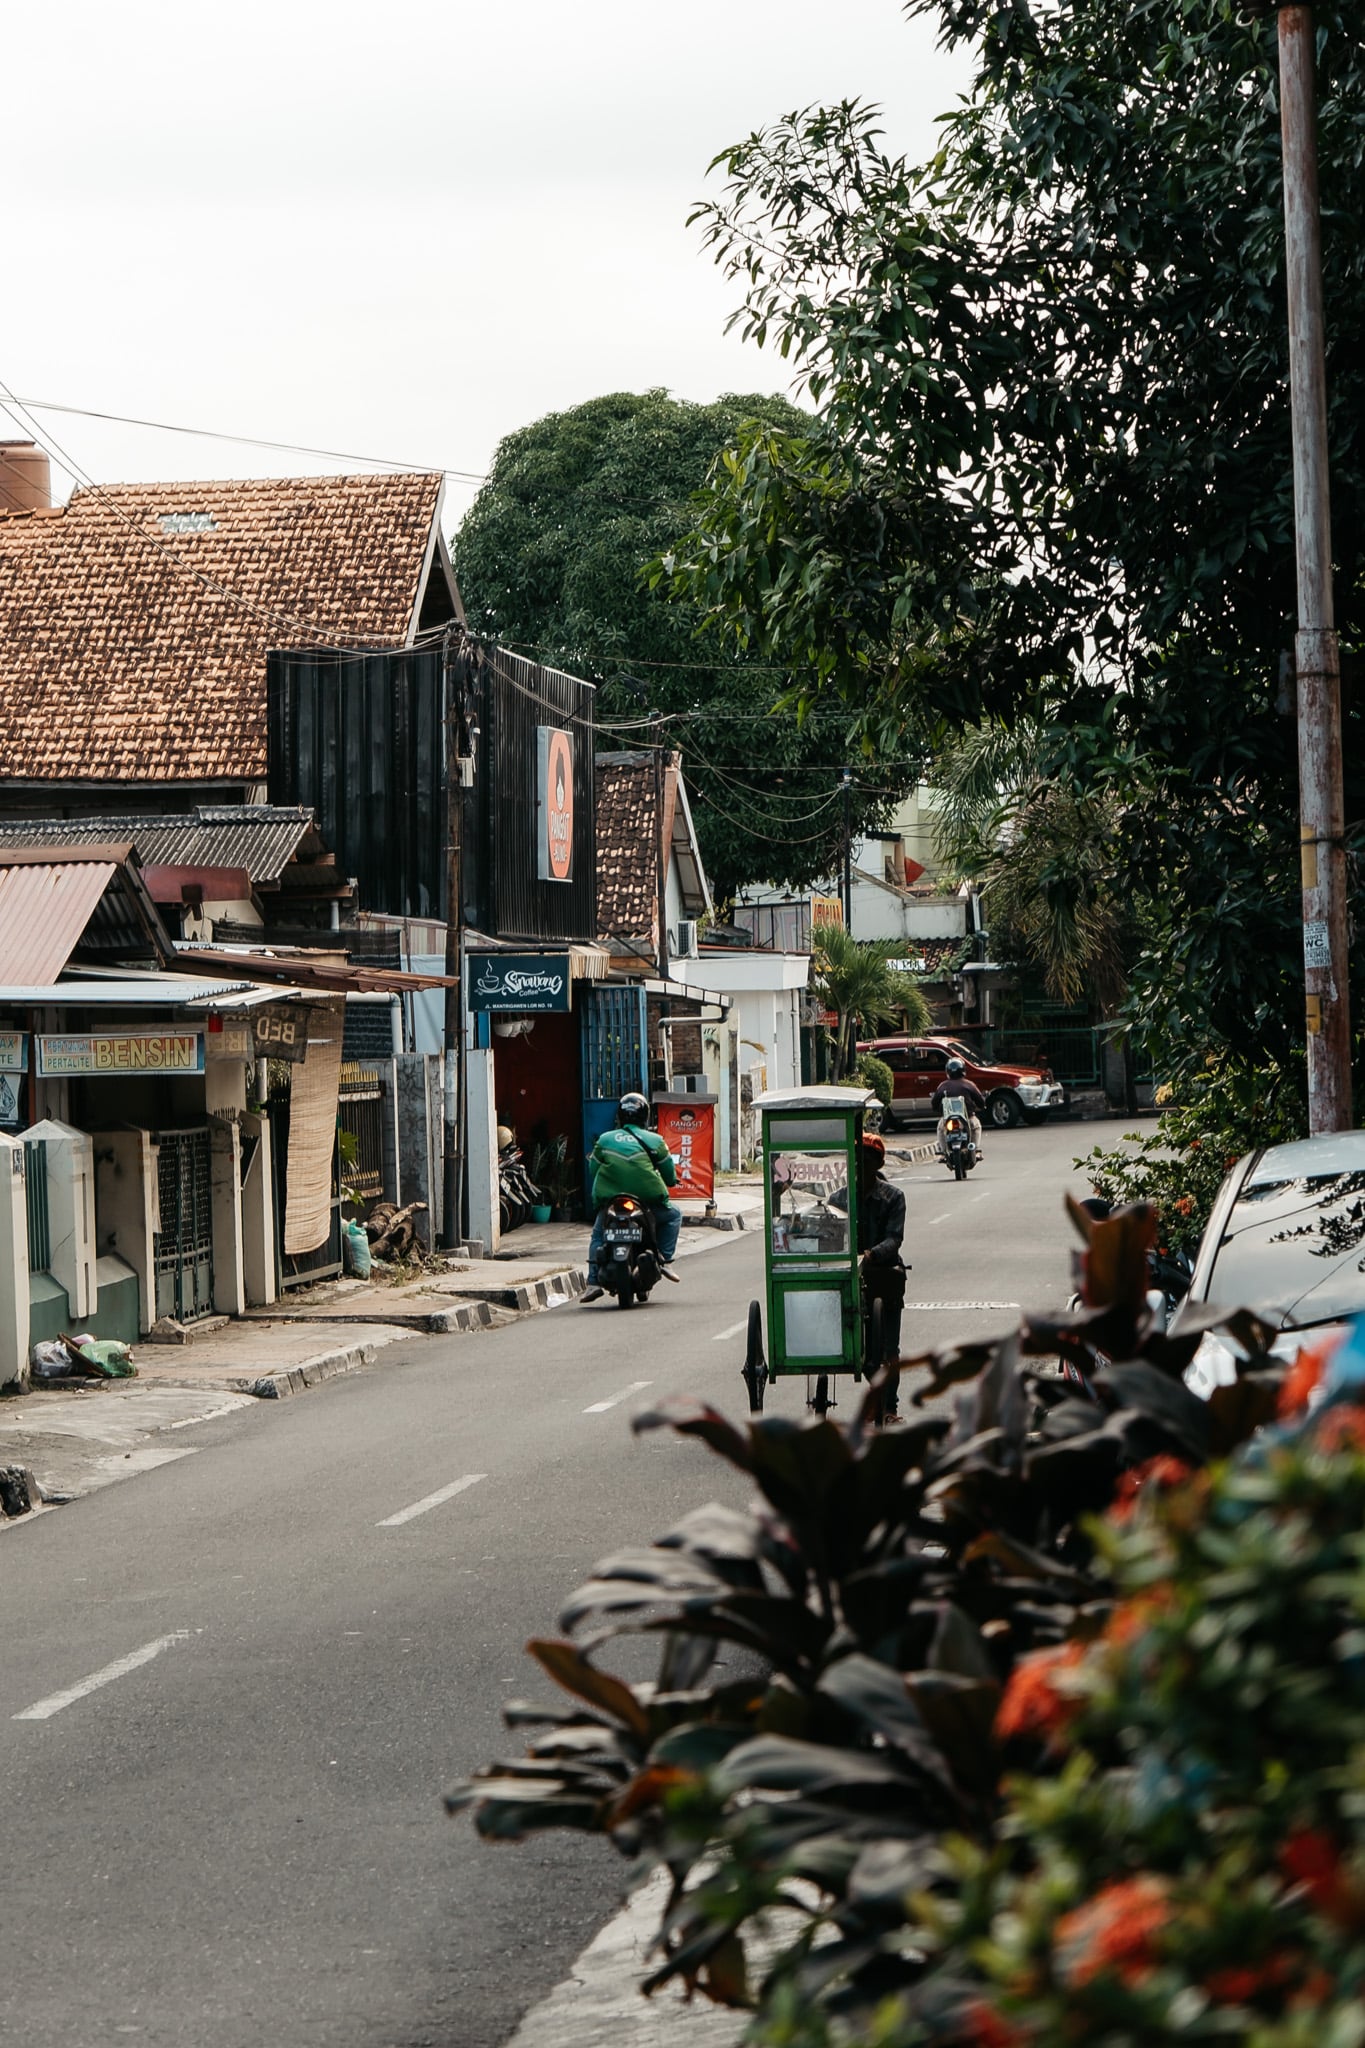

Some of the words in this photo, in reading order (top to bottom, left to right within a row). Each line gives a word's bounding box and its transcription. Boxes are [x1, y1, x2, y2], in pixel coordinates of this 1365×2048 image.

[1305, 939, 1324, 948] WC
[519, 989, 539, 997] Coffee
[96, 1037, 191, 1069] BENSIN
[47, 1057, 90, 1069] PERTALITE
[680, 1134, 693, 1180] BUKA
[773, 1157, 847, 1183] SIOMAY
